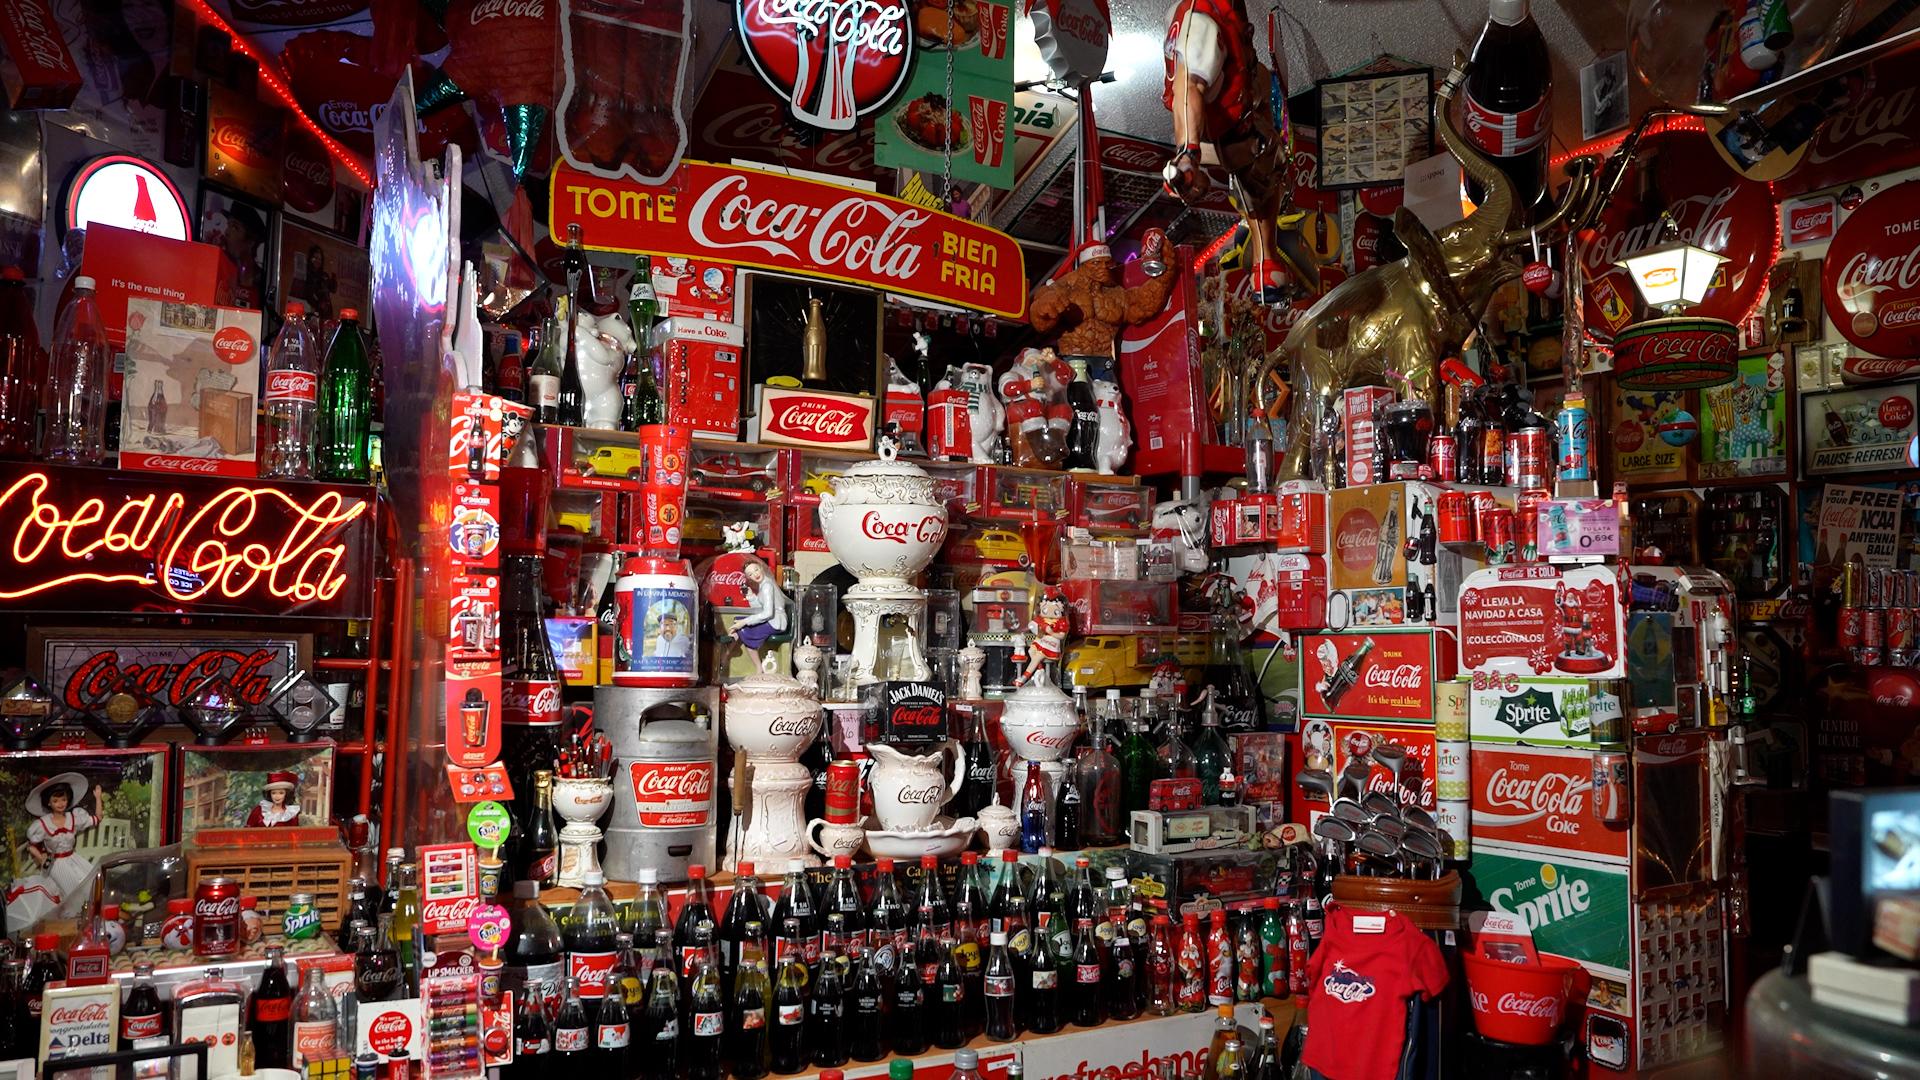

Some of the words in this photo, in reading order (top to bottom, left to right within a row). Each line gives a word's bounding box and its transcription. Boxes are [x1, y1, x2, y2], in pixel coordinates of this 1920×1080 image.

[566, 184, 678, 224] TOME
[688, 174, 933, 280] Coca-Cola
[942, 230, 998, 268] BIEN
[940, 260, 997, 296] FRIA
[111, 278, 125, 288] It's
[127, 281, 142, 291] the
[144, 284, 161, 294] real
[163, 287, 186, 300] thing
[704, 326, 727, 339] Coke
[801, 401, 828, 410] DRINK
[779, 404, 859, 437] Coca-Cola
[1622, 454, 1652, 467] LARGE
[1654, 454, 1676, 465] SIZE
[1849, 491, 1901, 509] FREE
[1858, 510, 1896, 531] NCAA
[1848, 532, 1896, 546] ANTENNA
[1481, 597, 1510, 607] LLEVA
[1511, 596, 1525, 605] LA
[1465, 610, 1506, 620] NAVIDAD
[1507, 609, 1515, 618] A
[1517, 608, 1543, 617] CASA
[1365, 663, 1423, 689] Coca-Cola
[889, 686, 911, 705] JACK
[1378, 696, 1390, 705] the
[1391, 697, 1403, 706] real
[1404, 697, 1421, 708] thing
[1590, 697, 1616, 713] prite
[1504, 703, 1551, 727] Sprite
[1509, 760, 1530, 772] Tome
[638, 769, 711, 797] Coca-Cola
[1486, 767, 1586, 816] Coca-Cola
[1545, 814, 1581, 836] Coke
[1514, 876, 1537, 893] Tome
[1489, 877, 1592, 932] Sprite
[284, 911, 320, 934] Sprite
[440, 966, 474, 977] SMACKER
[50, 1021, 110, 1035] ongratulates
[67, 1033, 110, 1048] Delta
